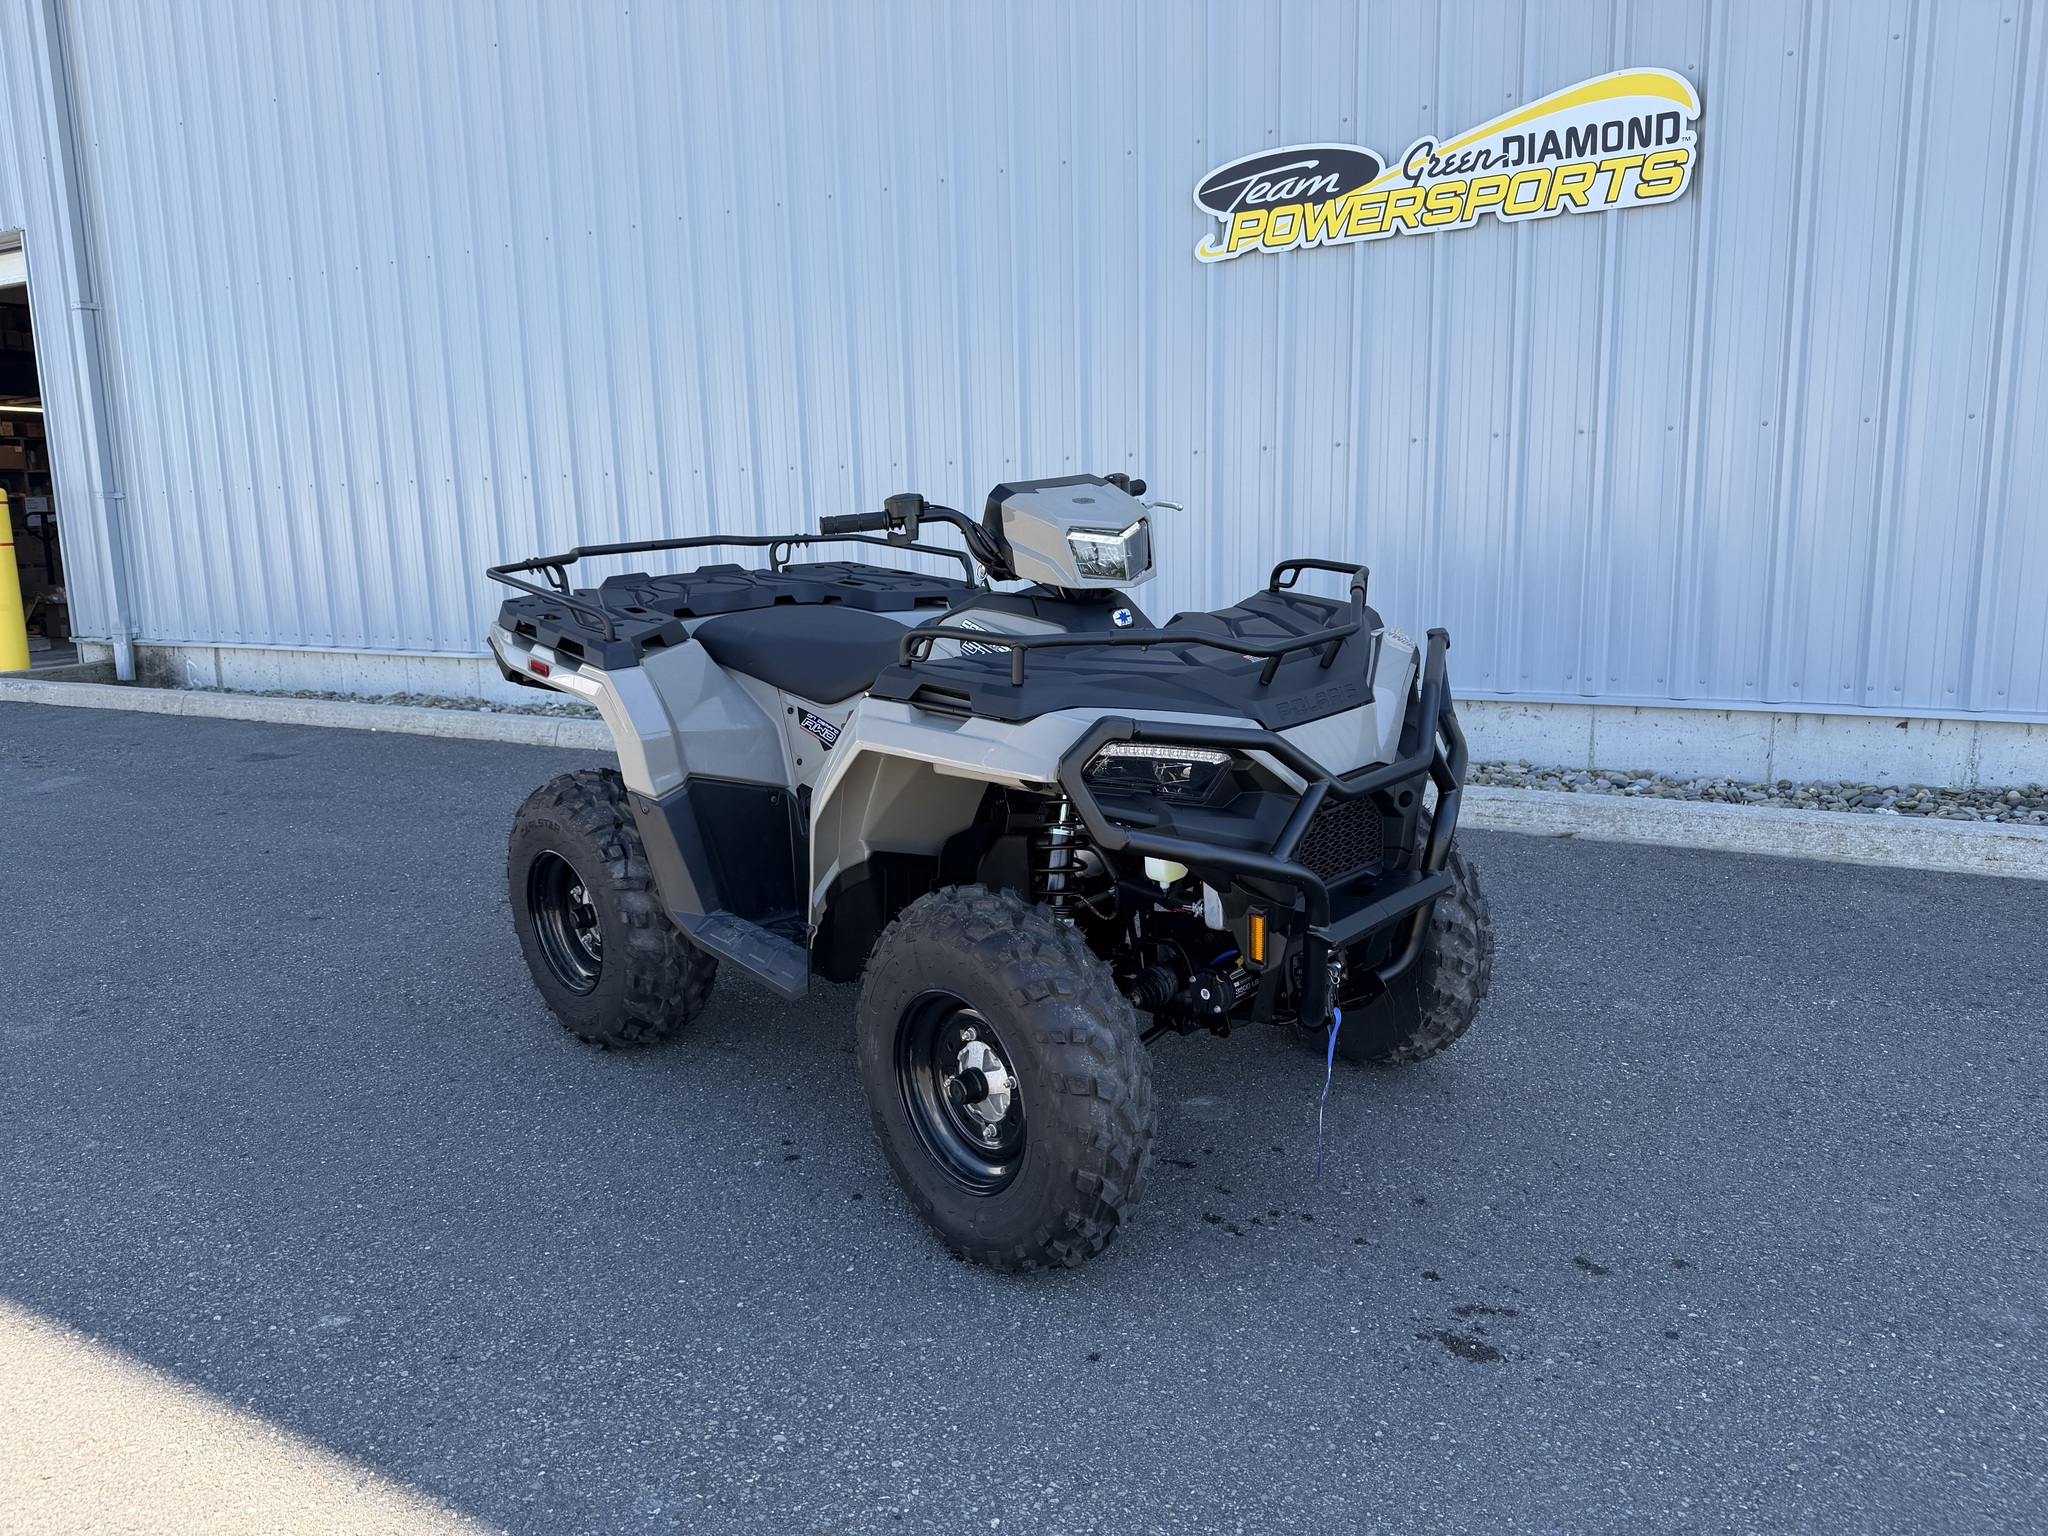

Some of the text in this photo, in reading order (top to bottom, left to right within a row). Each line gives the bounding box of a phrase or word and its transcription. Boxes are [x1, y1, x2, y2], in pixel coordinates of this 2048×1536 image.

[1402, 141, 1509, 187] Green
[1502, 111, 1681, 168] DIAMOND
[1200, 160, 1340, 213] Team
[1225, 148, 1690, 252] POWERSPORTS
[1275, 683, 1358, 721] POLARIS
[801, 717, 837, 742] AWD
